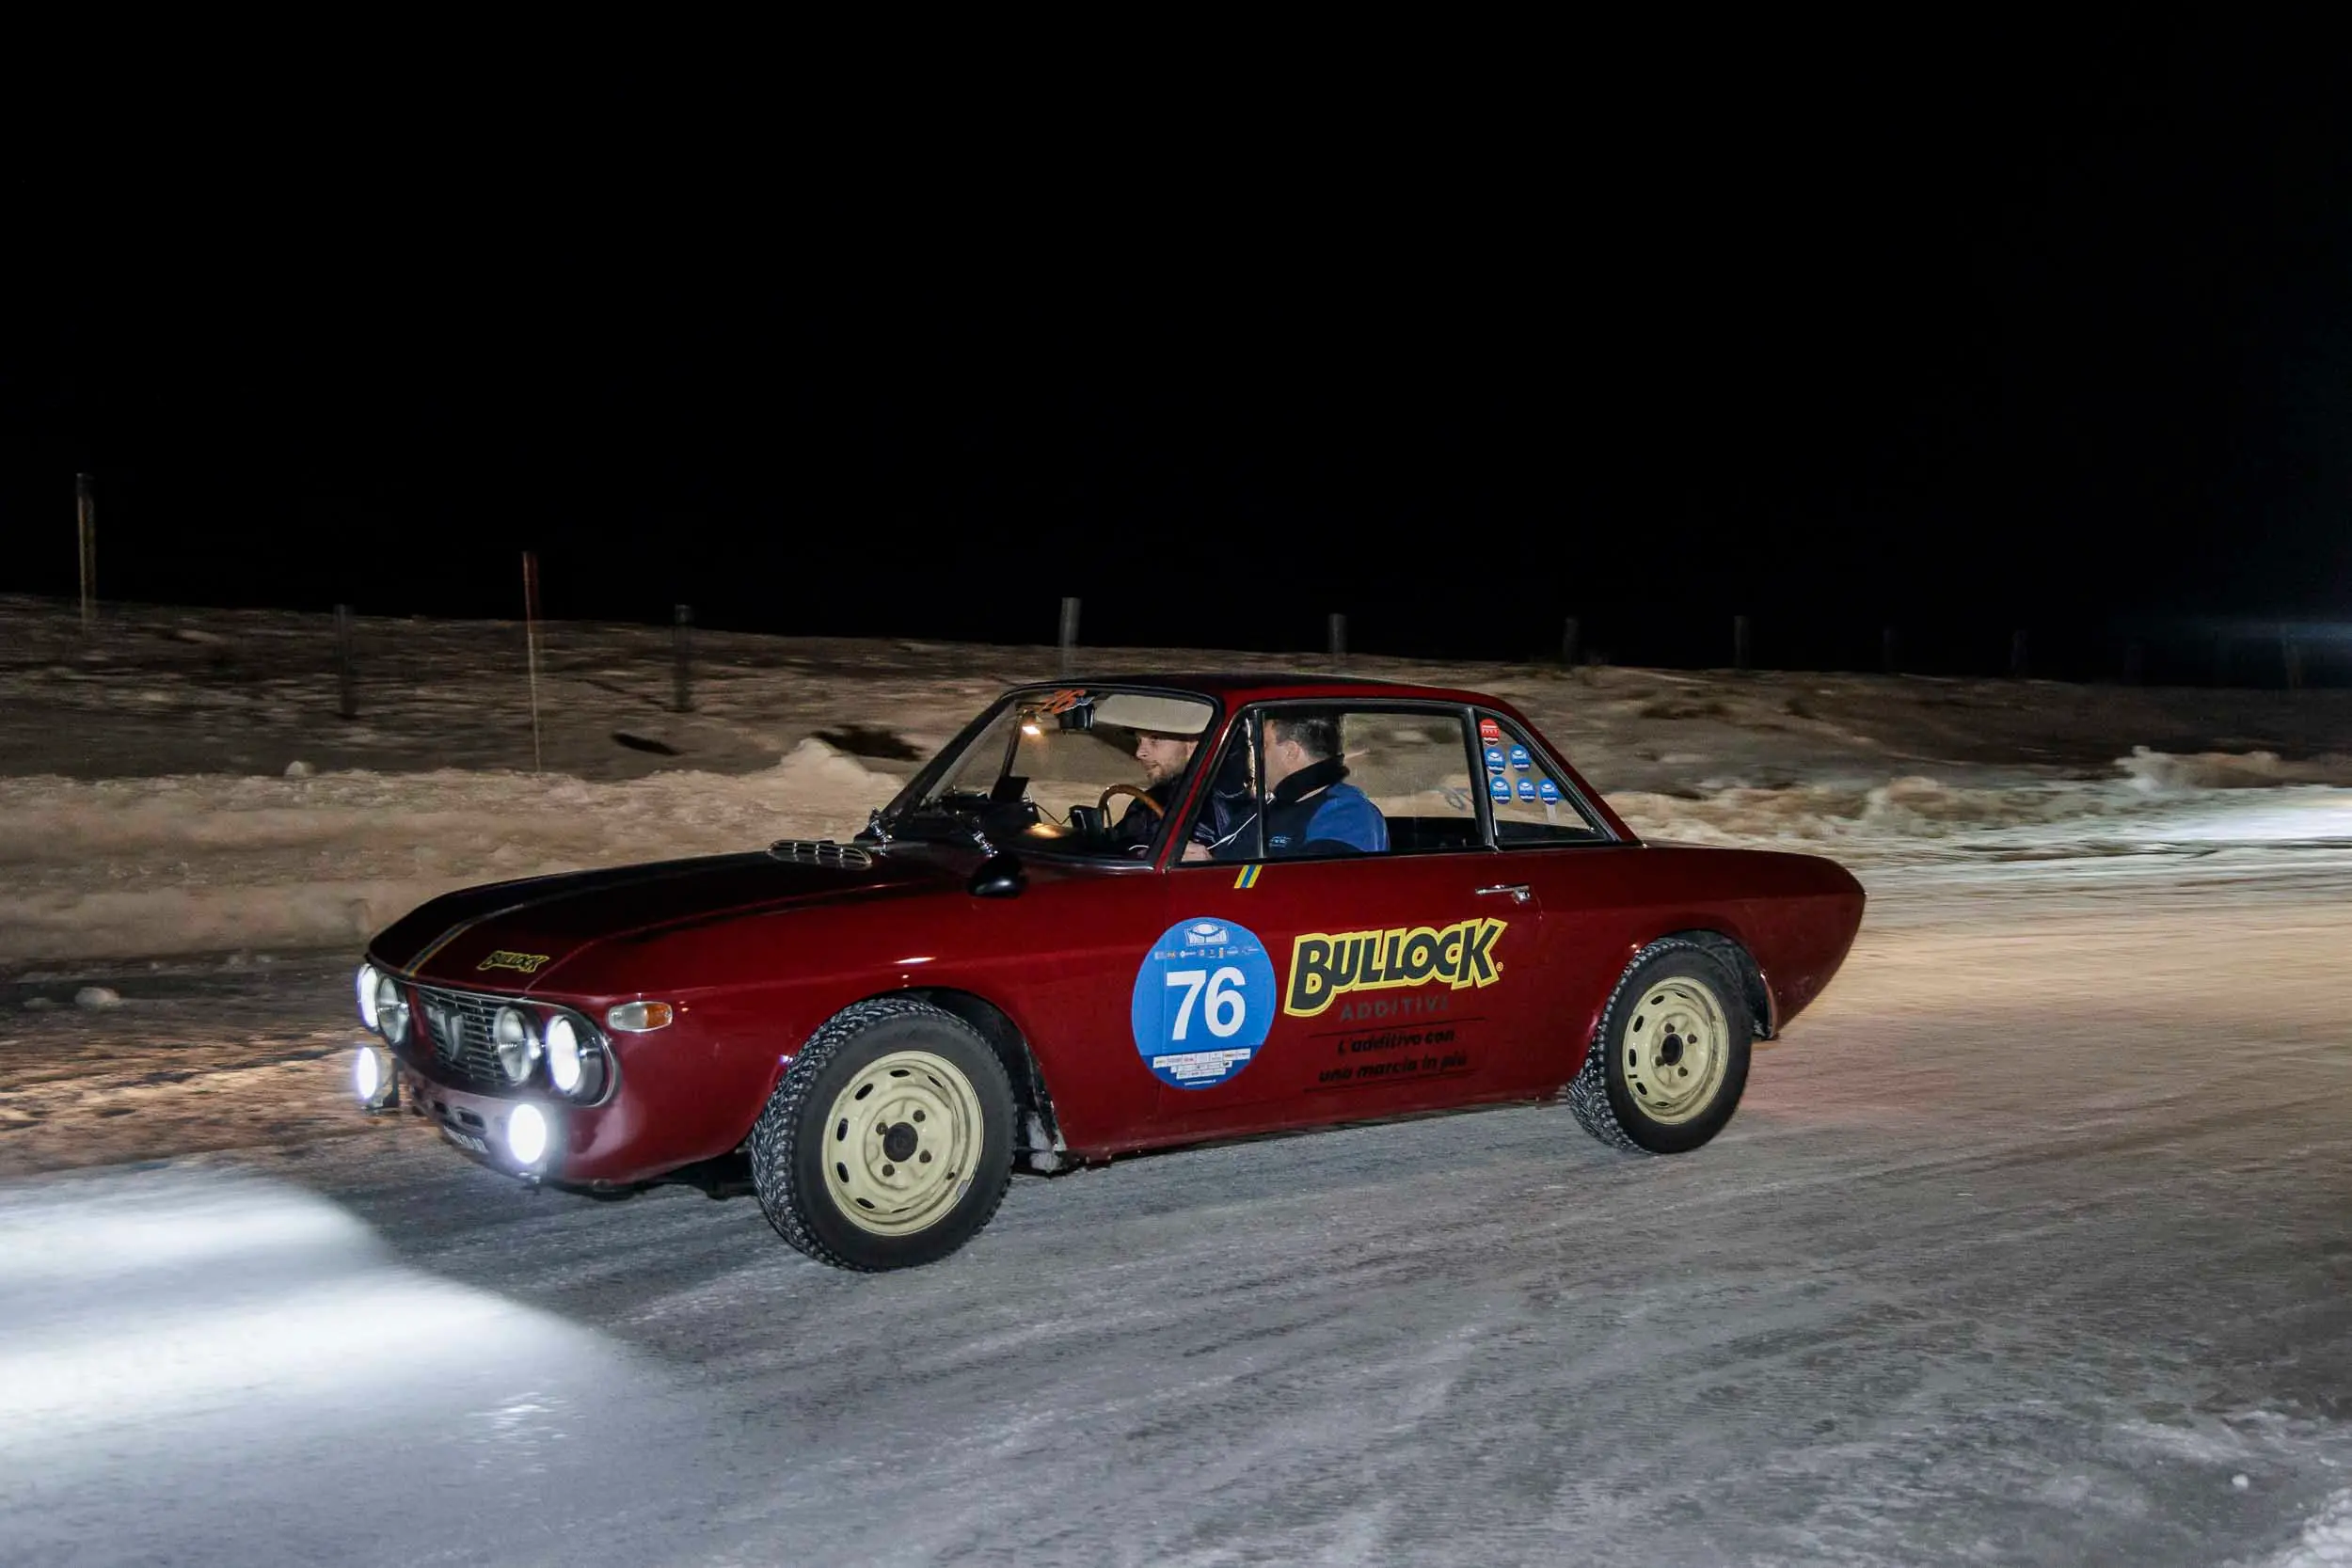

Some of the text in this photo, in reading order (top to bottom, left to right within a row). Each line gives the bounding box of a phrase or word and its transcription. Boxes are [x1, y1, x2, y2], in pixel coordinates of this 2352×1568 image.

[1283, 918, 1508, 1017] BULLOCK
[1167, 967, 1246, 1040] 76
[1339, 994, 1449, 1023] ADDITIVI
[1424, 1029, 1455, 1044] con
[1318, 1067, 1352, 1083] una
[1357, 1055, 1417, 1077] marcia
[1422, 1053, 1437, 1069] in
